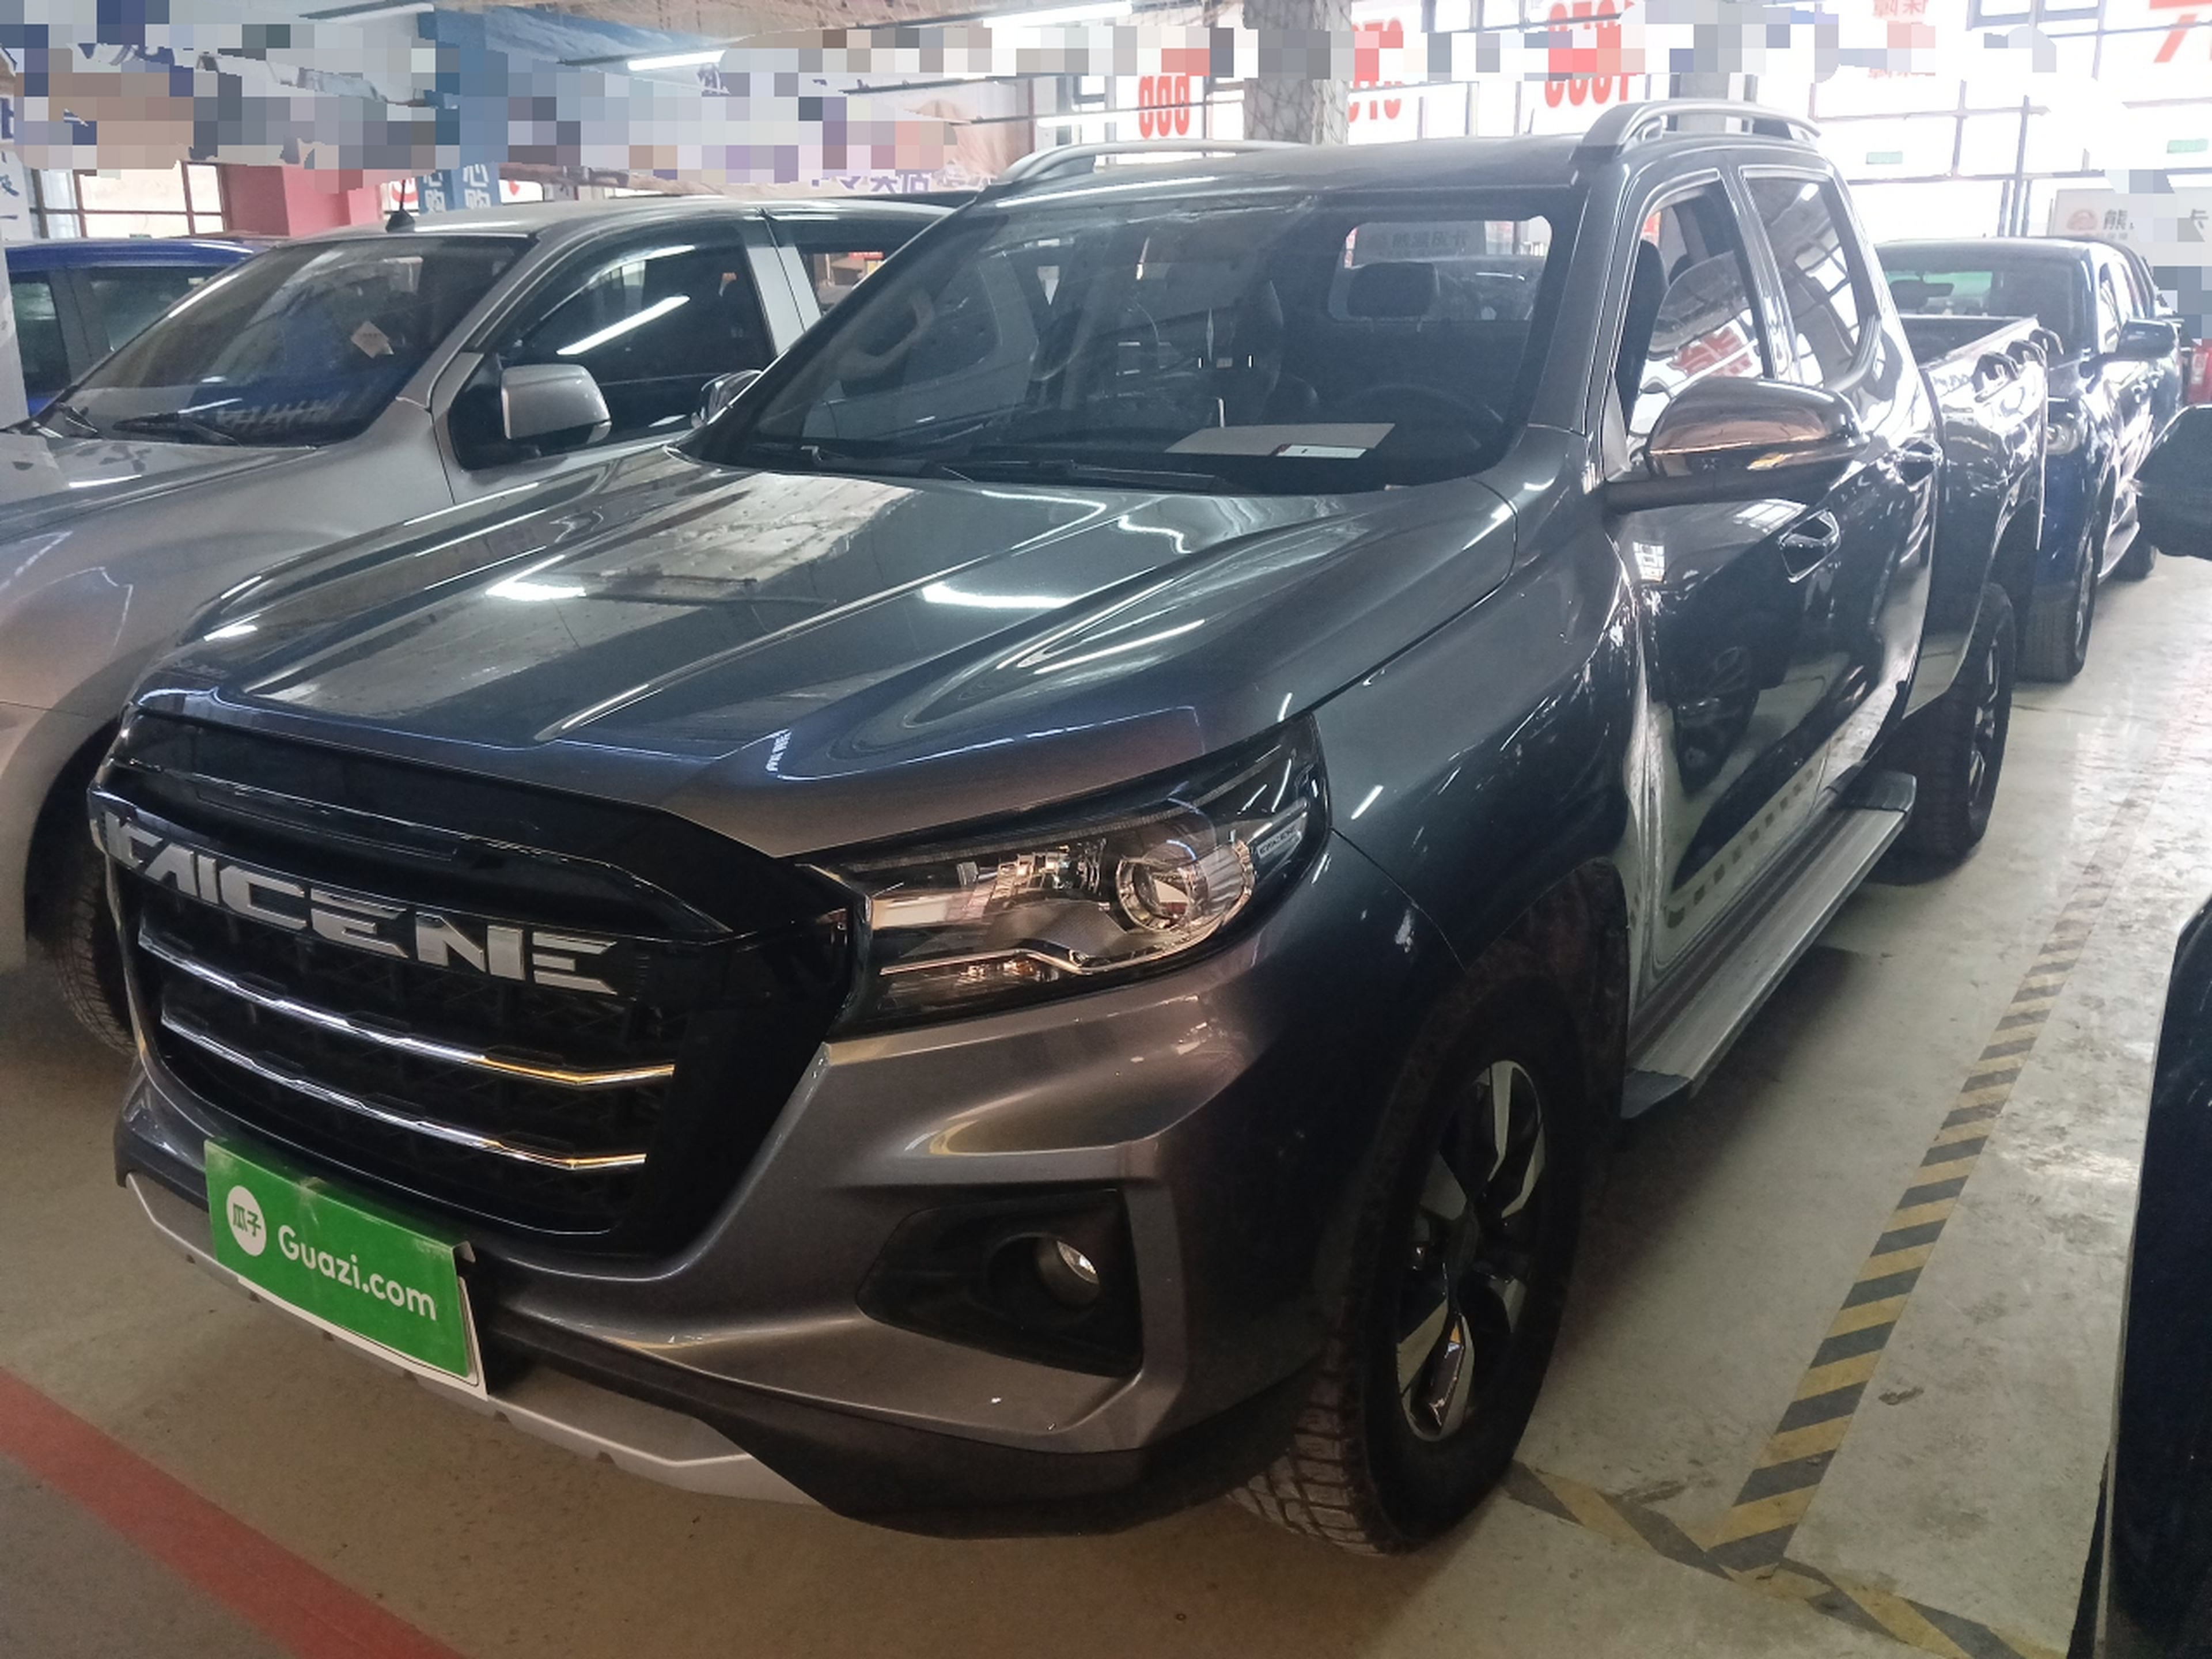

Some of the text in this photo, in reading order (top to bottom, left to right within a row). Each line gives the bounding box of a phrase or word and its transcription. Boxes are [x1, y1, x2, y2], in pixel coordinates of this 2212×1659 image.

[105, 810, 618, 995] KAICENE
[233, 1202, 262, 1238] 瓜子
[278, 1225, 437, 1321] Guazi.com
